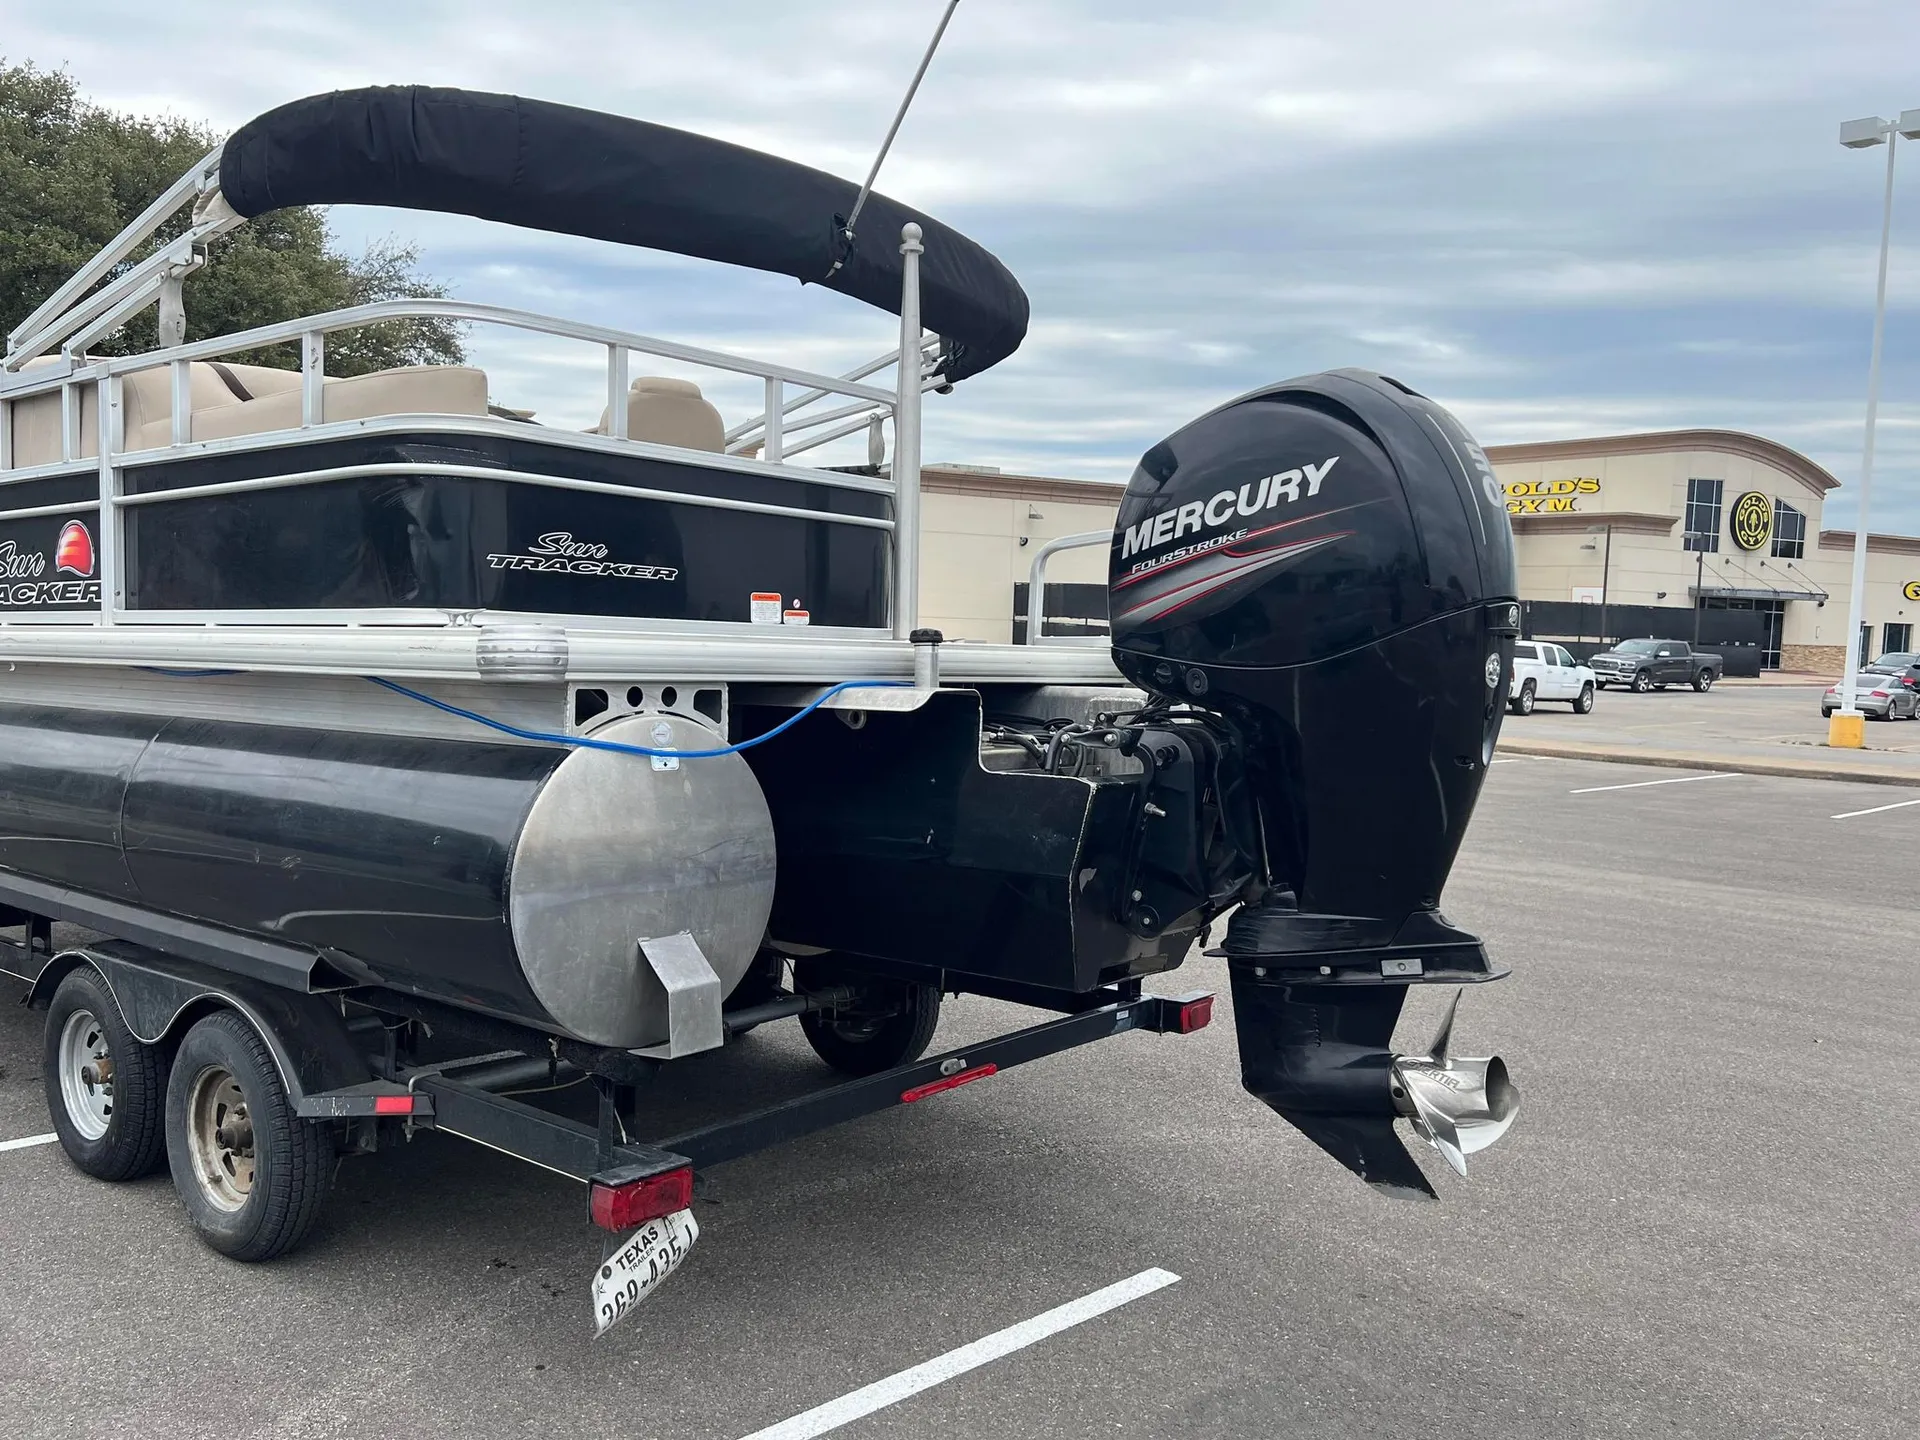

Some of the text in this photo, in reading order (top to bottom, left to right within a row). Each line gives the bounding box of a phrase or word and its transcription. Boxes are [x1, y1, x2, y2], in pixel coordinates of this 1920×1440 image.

[1501, 478, 1601, 497] OLD'S
[1121, 456, 1340, 560] MERCURY
[1505, 497, 1578, 513] GYM
[528, 531, 609, 559] Sun
[1740, 529, 1766, 545] GYM
[1131, 528, 1250, 575] FOURSTROKE
[486, 553, 679, 582] TRACKER
[615, 1226, 659, 1271] TEXAS
[628, 1246, 656, 1274] TRAILER
